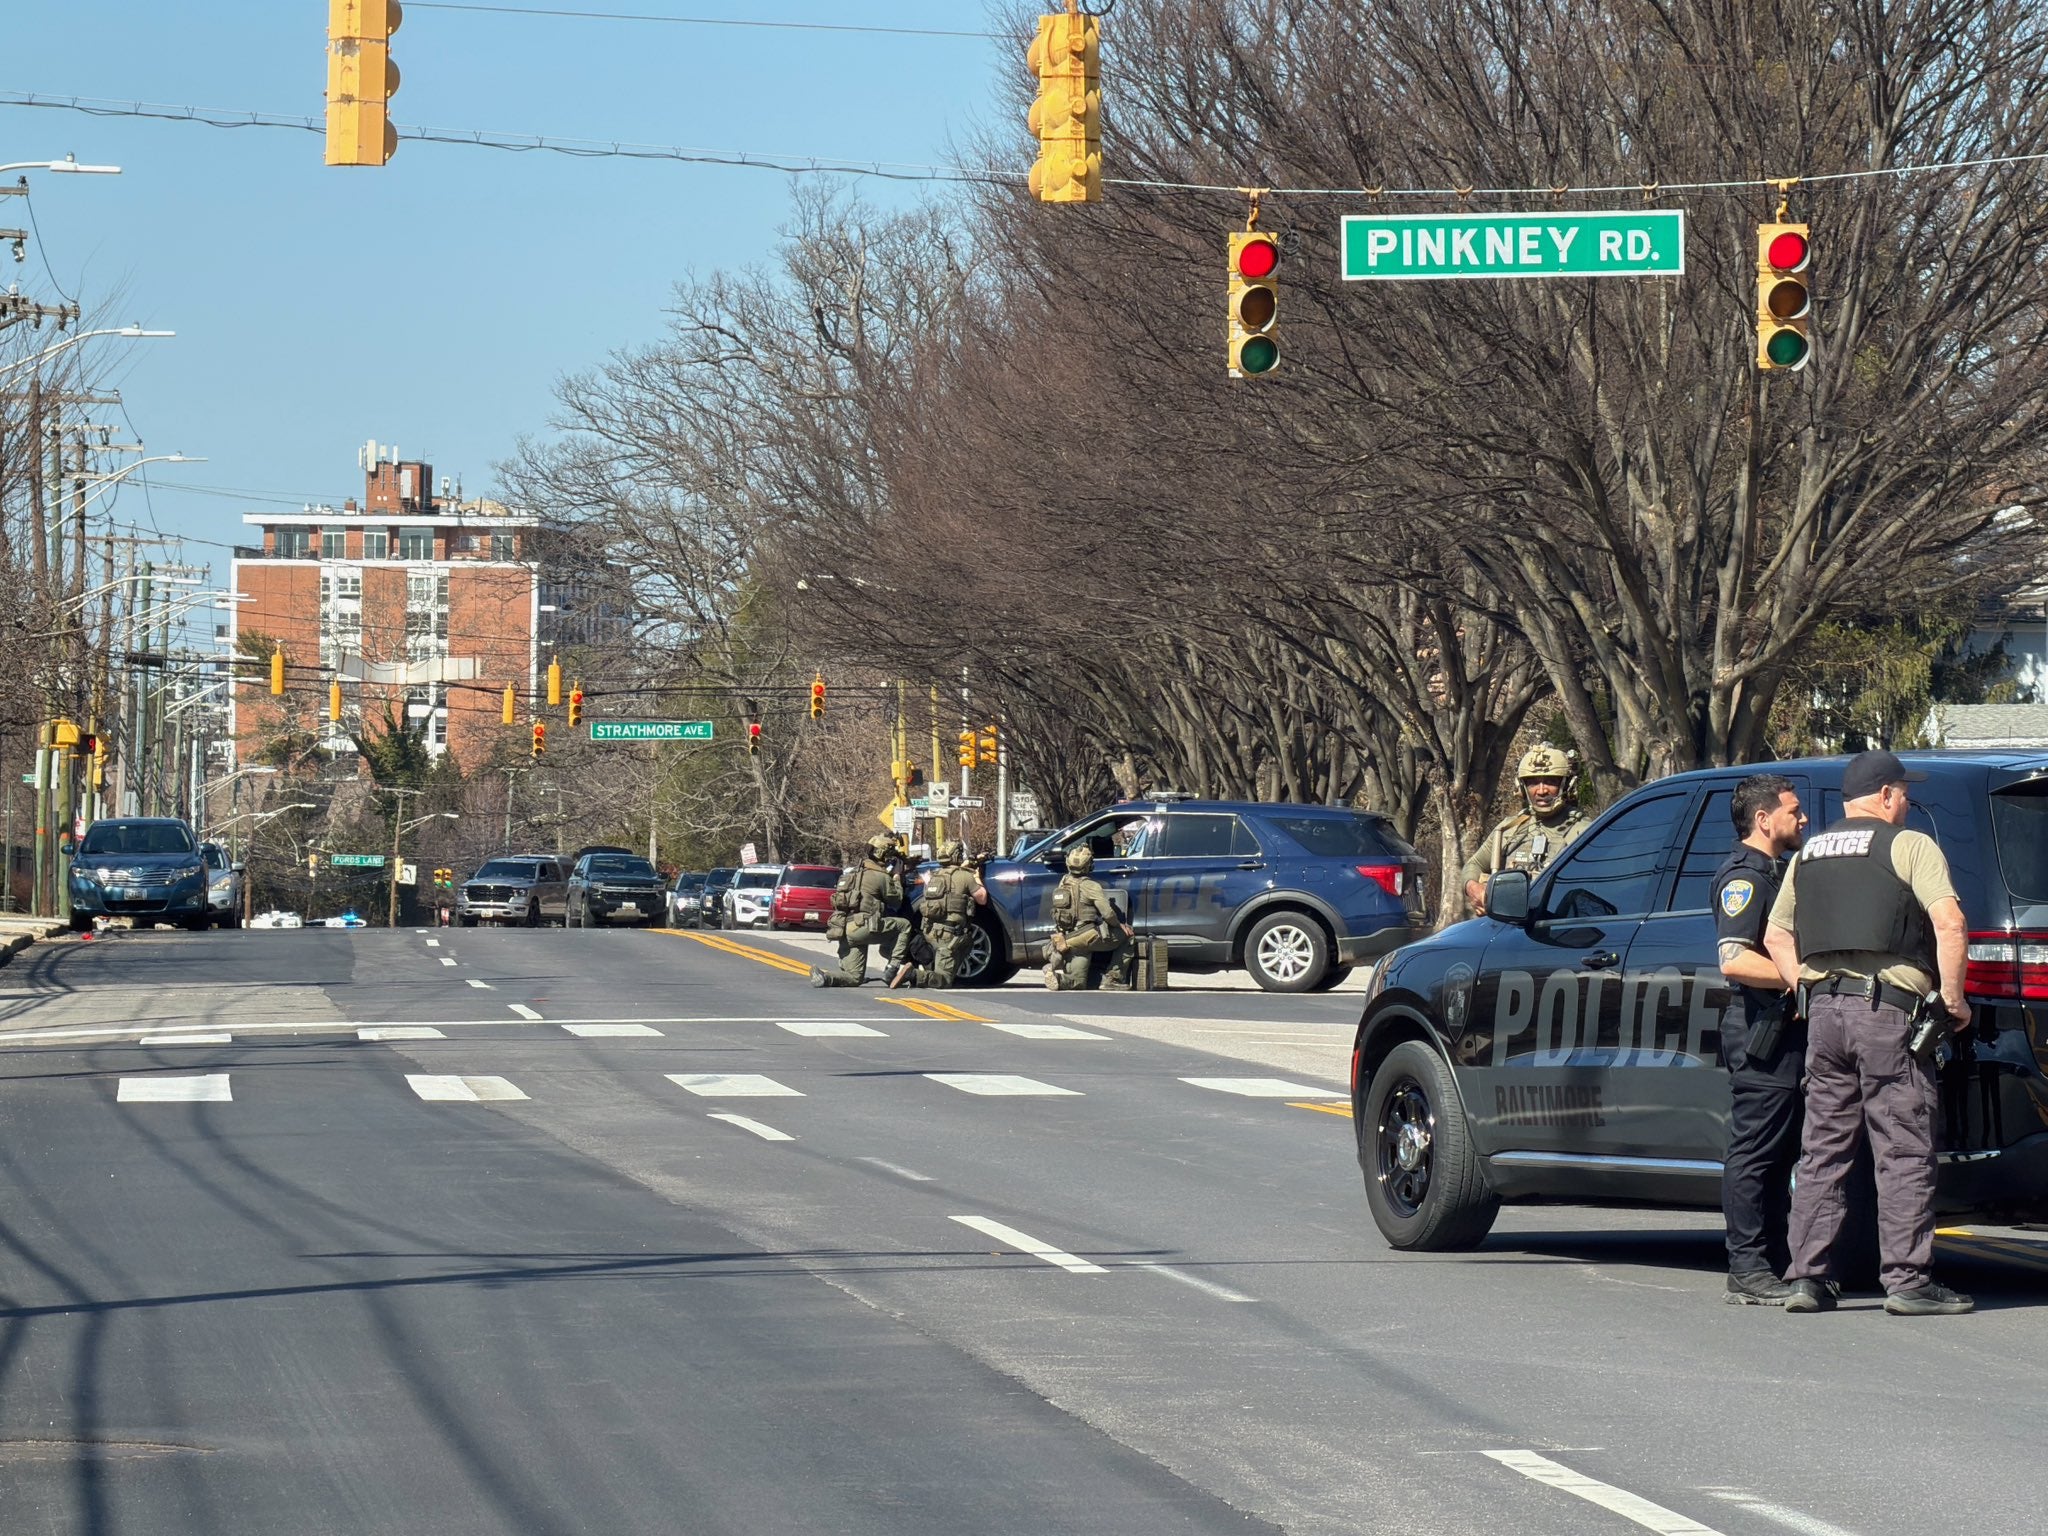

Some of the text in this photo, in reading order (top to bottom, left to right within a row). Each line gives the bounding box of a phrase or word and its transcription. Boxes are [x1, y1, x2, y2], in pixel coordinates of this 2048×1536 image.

[1367, 226, 1661, 267] PINKNEY RD.
[596, 725, 708, 737] STRATHMORE AVE.
[334, 856, 383, 865] FORDS LANE
[1802, 837, 1872, 861] POLICE
[1491, 965, 1731, 1067] POLICE
[1494, 1085, 1606, 1128] BALTIMORE
